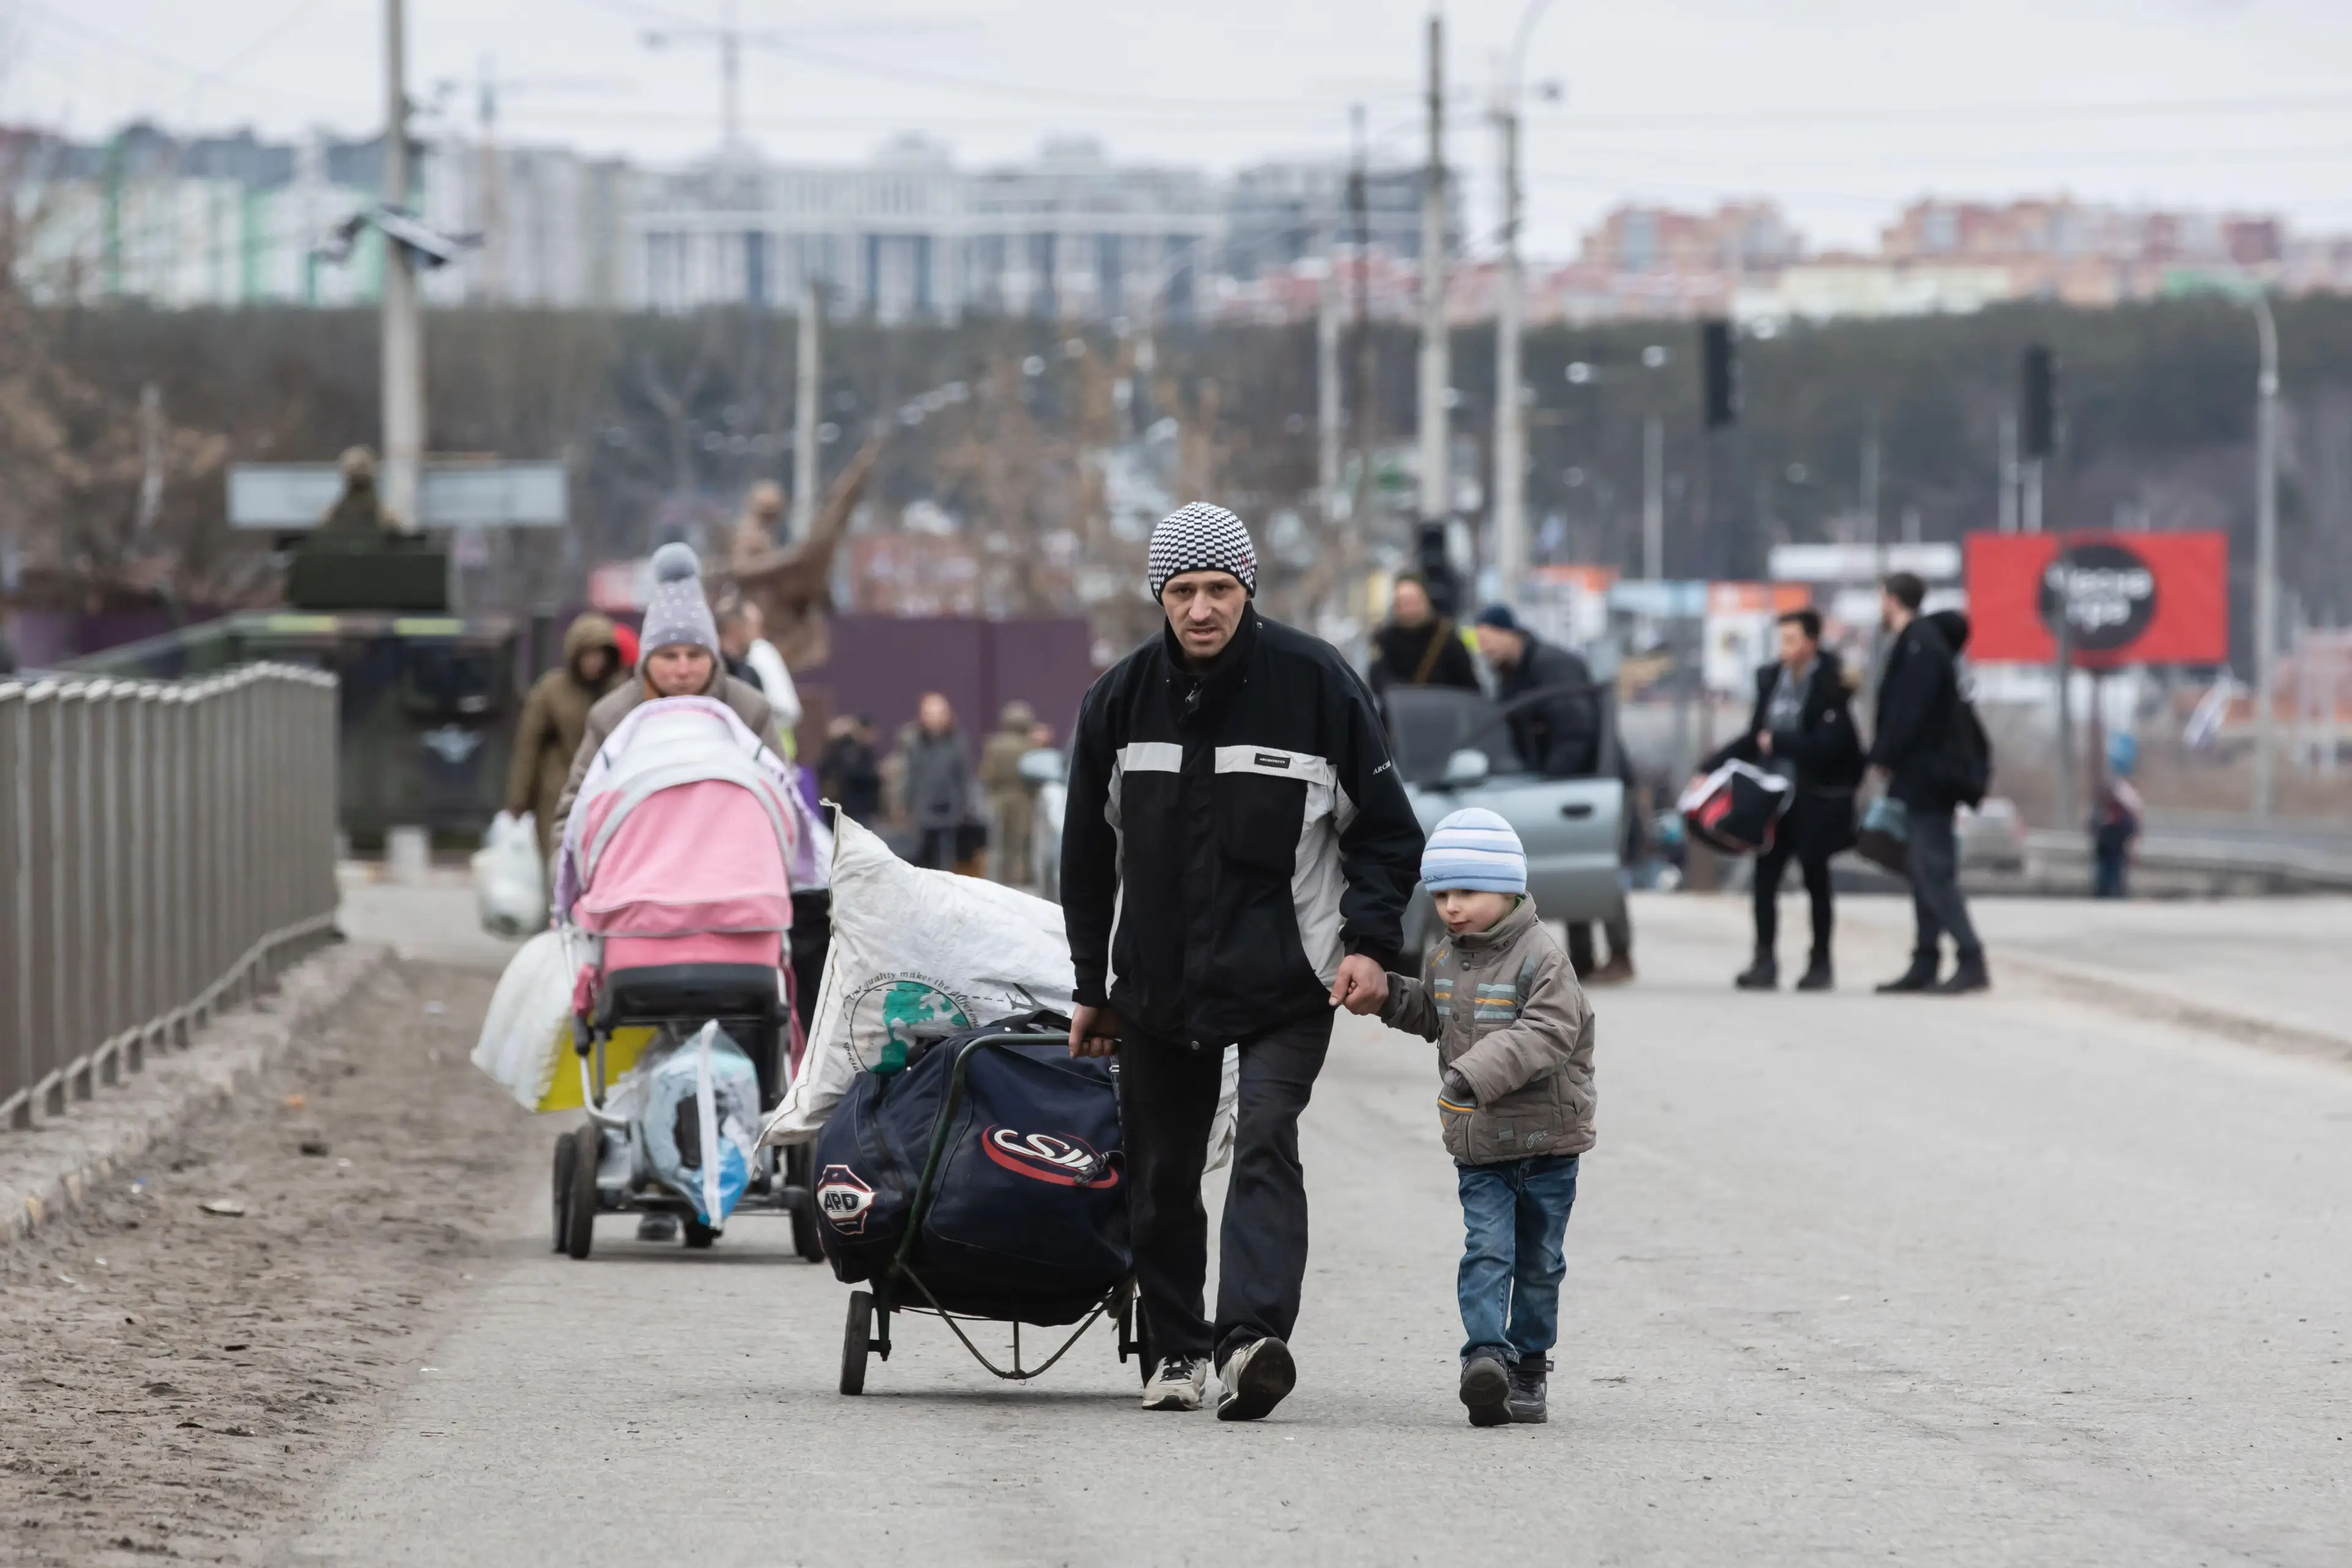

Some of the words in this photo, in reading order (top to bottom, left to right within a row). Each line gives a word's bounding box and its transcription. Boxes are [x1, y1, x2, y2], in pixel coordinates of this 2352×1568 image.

[864, 972, 895, 989] quality
[900, 971, 933, 981] makes
[934, 979, 950, 991] the
